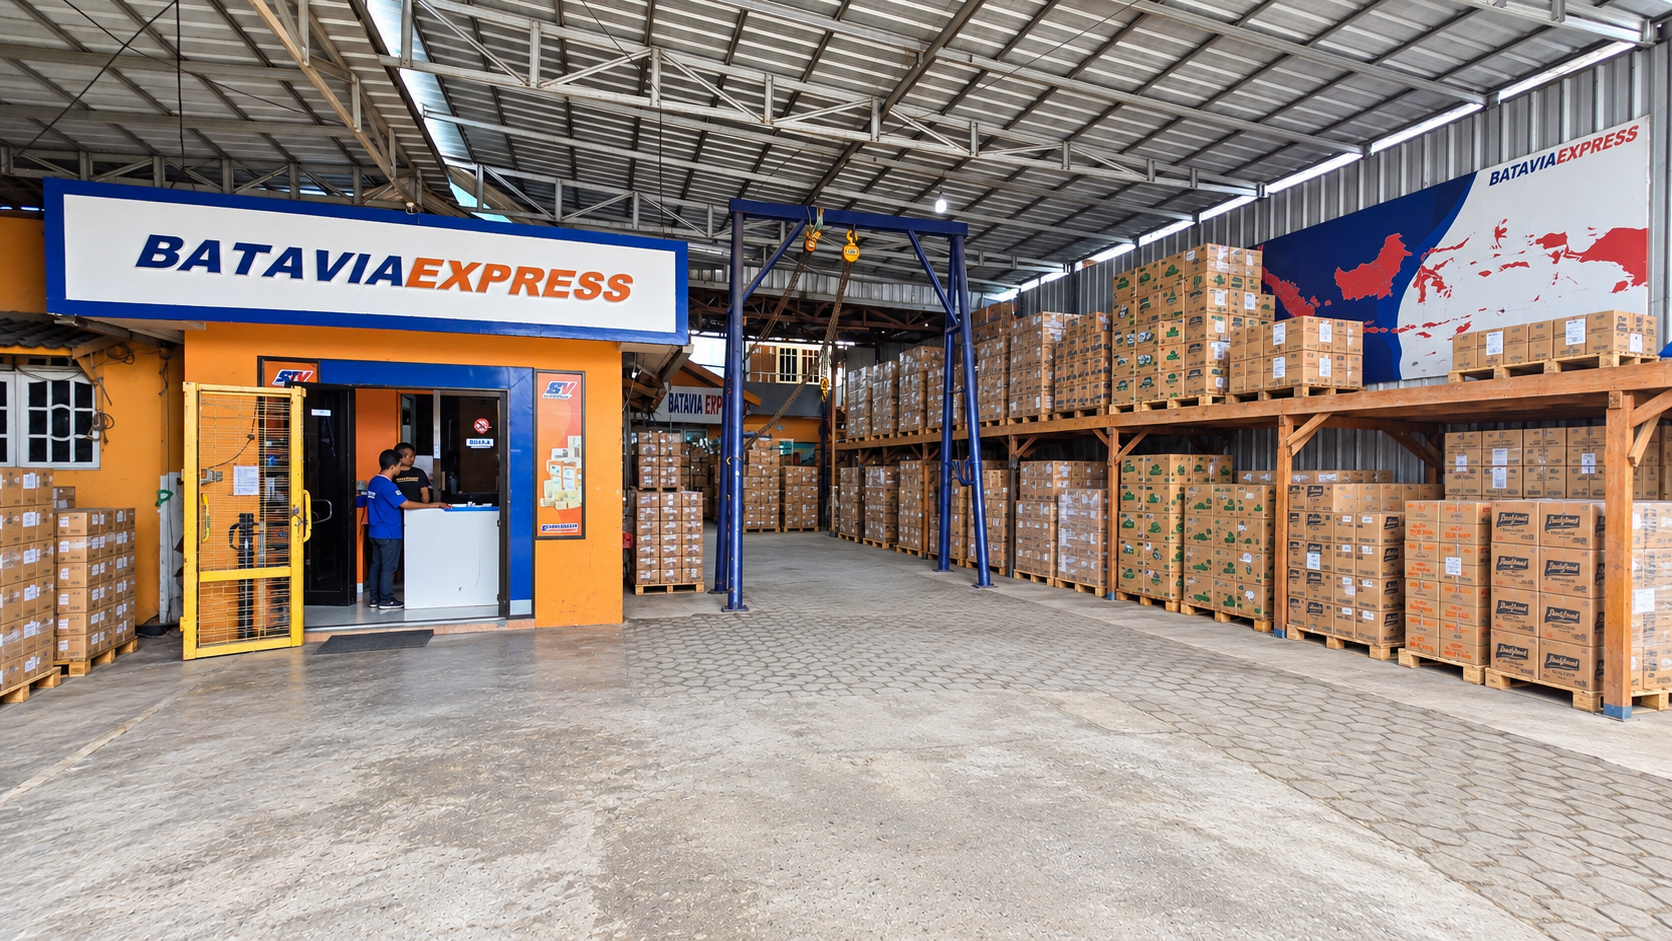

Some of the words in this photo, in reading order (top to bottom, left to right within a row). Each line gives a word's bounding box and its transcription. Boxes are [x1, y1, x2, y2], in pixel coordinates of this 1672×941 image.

[1489, 125, 1640, 187] BATAVIAEXPRESS
[135, 233, 634, 303] BATAVIAEXPRESS
[668, 392, 703, 415] BATAVIA
